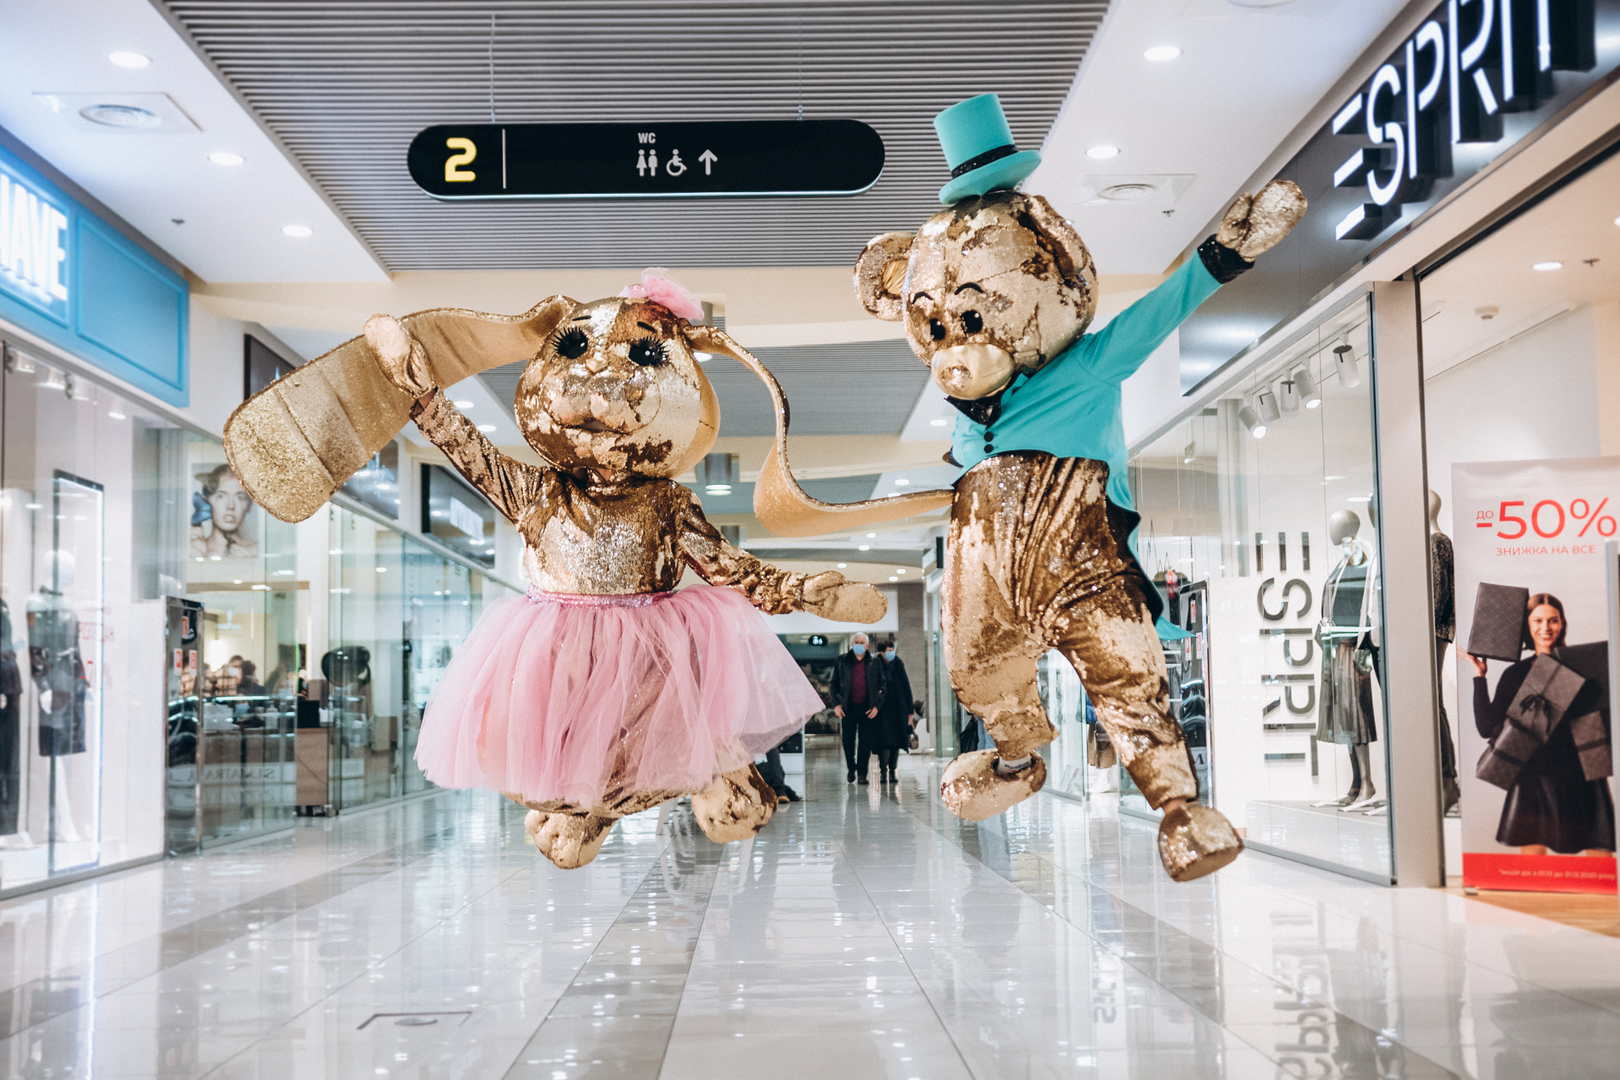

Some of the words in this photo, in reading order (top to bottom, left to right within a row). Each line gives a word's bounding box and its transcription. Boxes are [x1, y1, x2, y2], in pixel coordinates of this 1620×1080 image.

[638, 132, 656, 144] WC
[445, 137, 477, 182] 2
[1496, 546, 1548, 556] ЗНИЖКА
[1552, 546, 1569, 554] НА
[1572, 545, 1596, 554] ВСЕ
[1255, 532, 1319, 777] ESPRIT
